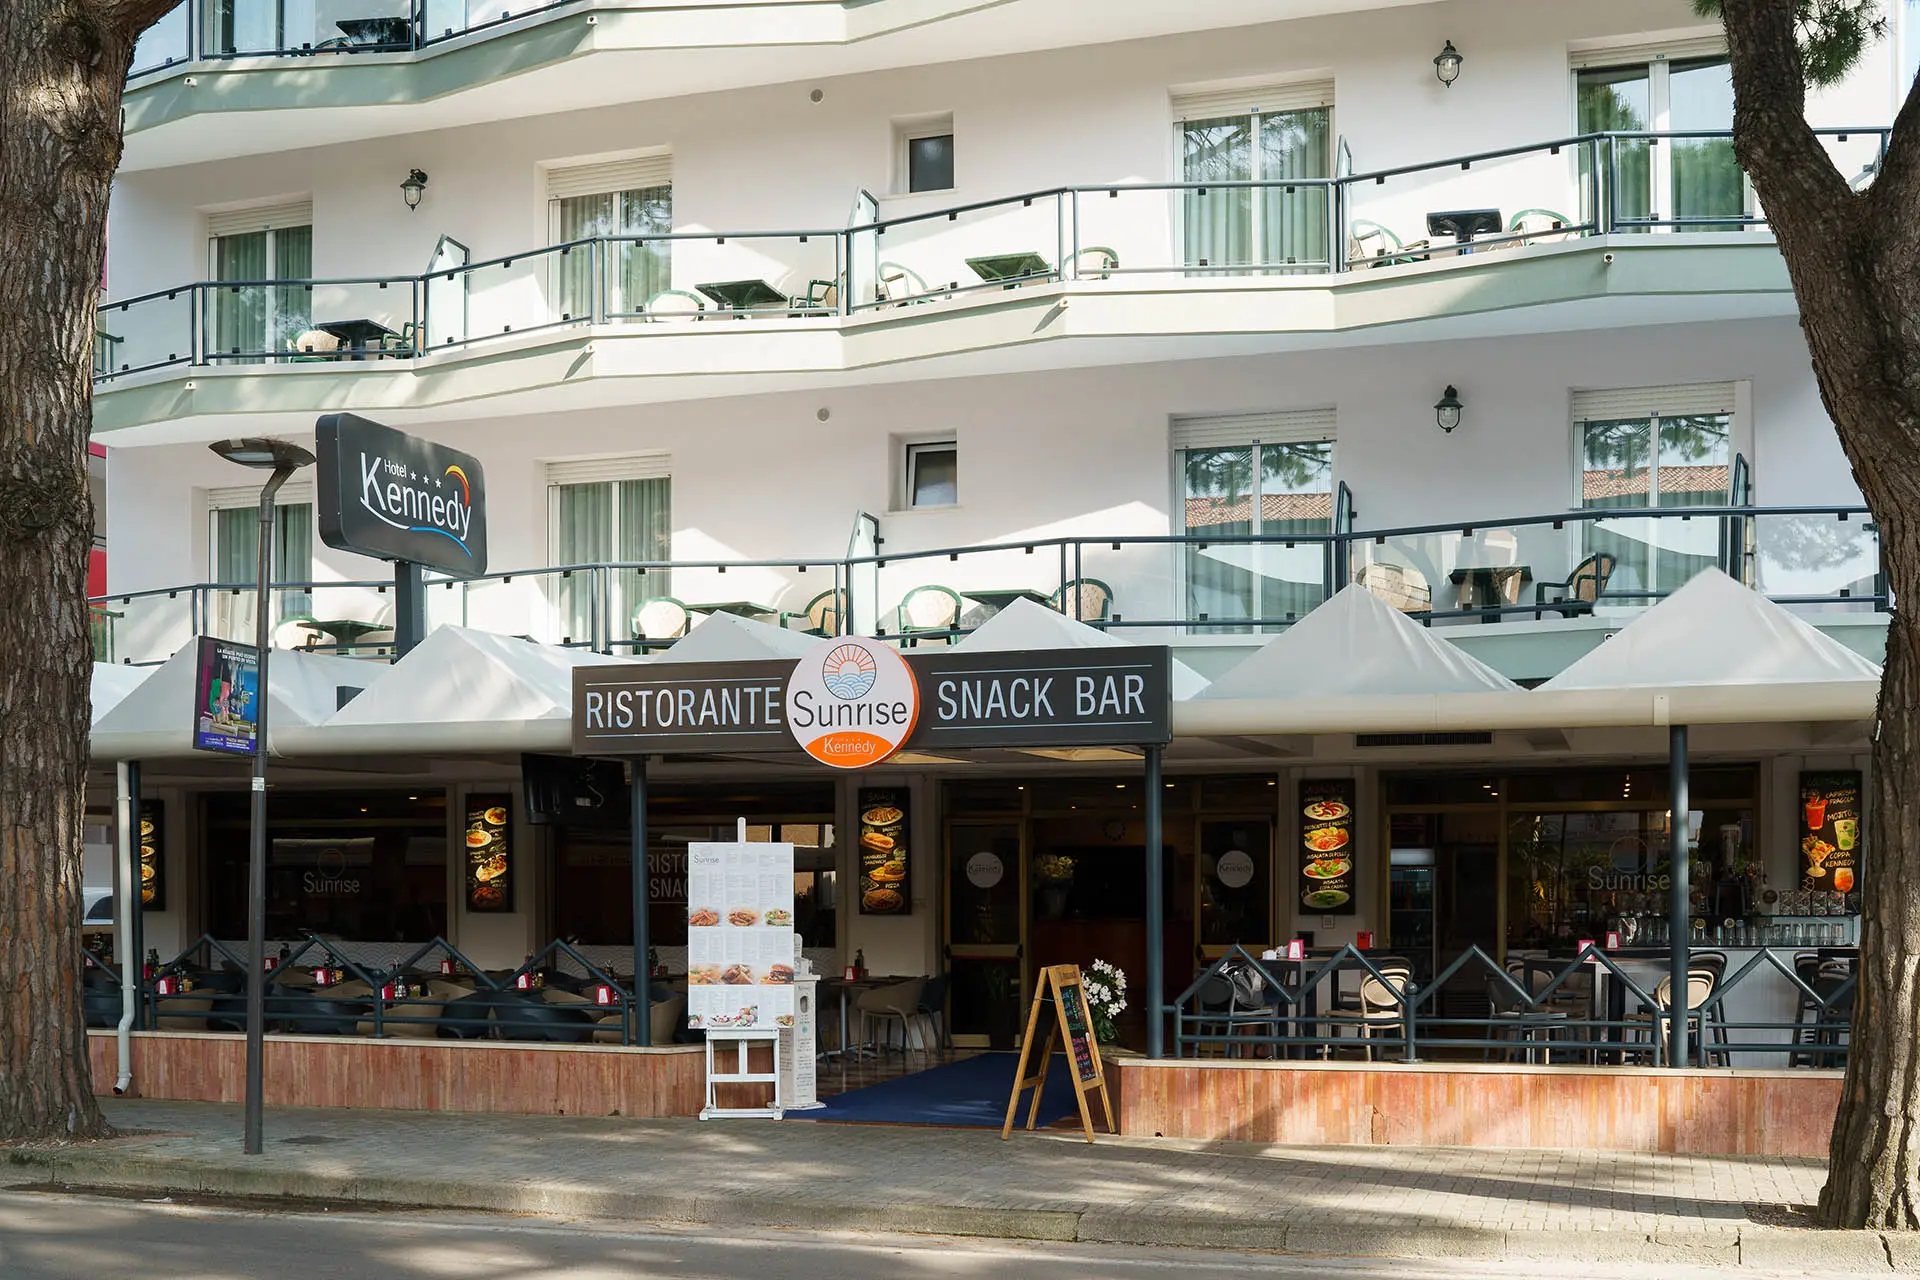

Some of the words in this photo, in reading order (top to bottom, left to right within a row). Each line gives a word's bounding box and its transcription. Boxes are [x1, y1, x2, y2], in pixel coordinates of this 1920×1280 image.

[384, 459, 407, 478] Hotel
[361, 452, 472, 541] Kennedy
[586, 685, 781, 729] RISTORANTE
[793, 690, 908, 728] Sunrise
[937, 677, 1055, 721] SNACK
[1076, 674, 1145, 716] BAR
[823, 737, 877, 755] Kennedy
[1826, 809, 1852, 821] MOJITO
[1825, 860, 1856, 868] KENNEDY
[1829, 851, 1851, 860] COPPA
[302, 871, 361, 895] Sunrise
[1588, 864, 1671, 891] Sunrise
